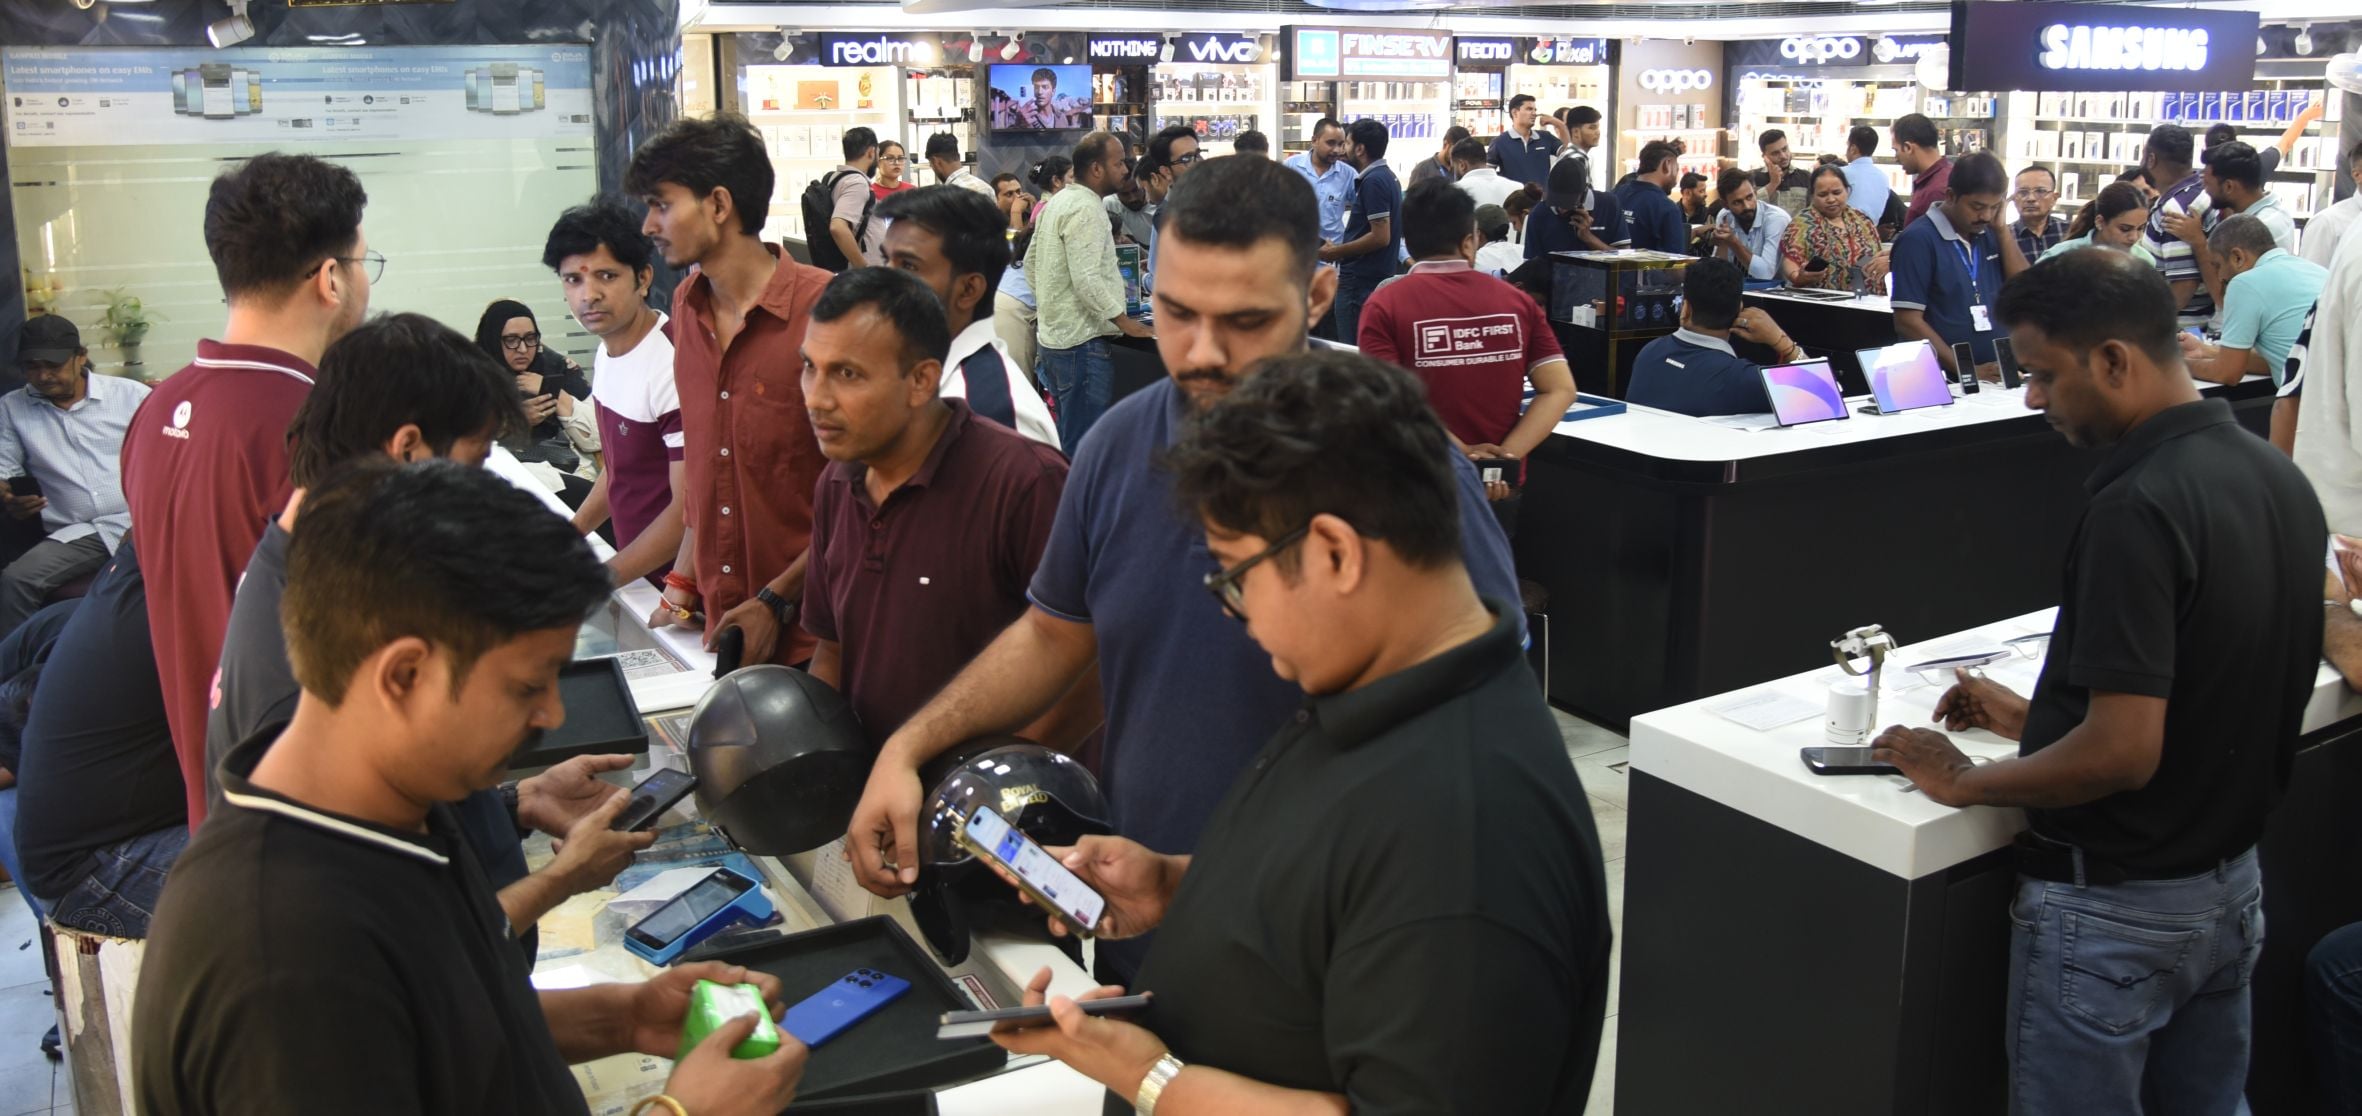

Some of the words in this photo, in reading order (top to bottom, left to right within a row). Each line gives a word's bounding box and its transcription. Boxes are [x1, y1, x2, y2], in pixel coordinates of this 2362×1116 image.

[832, 35, 932, 64] realm
[1090, 40, 1158, 57] NOTHING
[1189, 35, 1261, 62] vivo
[1342, 33, 1449, 57] FINSERV
[1458, 42, 1512, 59] TECNO
[1780, 37, 1861, 64] oppo
[2040, 23, 2209, 71] SAMSUNG
[10, 66, 38, 74] Latest
[39, 66, 97, 76] smartphones
[112, 67, 132, 76] easy
[322, 65, 347, 74] Latest
[347, 65, 399, 76] smartphones
[411, 67, 430, 75] easy
[1638, 69, 1713, 95] oppo
[1453, 327, 1480, 339] IDFC
[1482, 324, 1514, 336] FIRST
[1455, 340, 1484, 351] Bank
[1415, 358, 1465, 368] CONSUMER
[1466, 354, 1504, 365] DURABLE
[162, 425, 190, 440] motola
[1000, 783, 1040, 799] ROYAL
[1000, 792, 1048, 813] EELD
